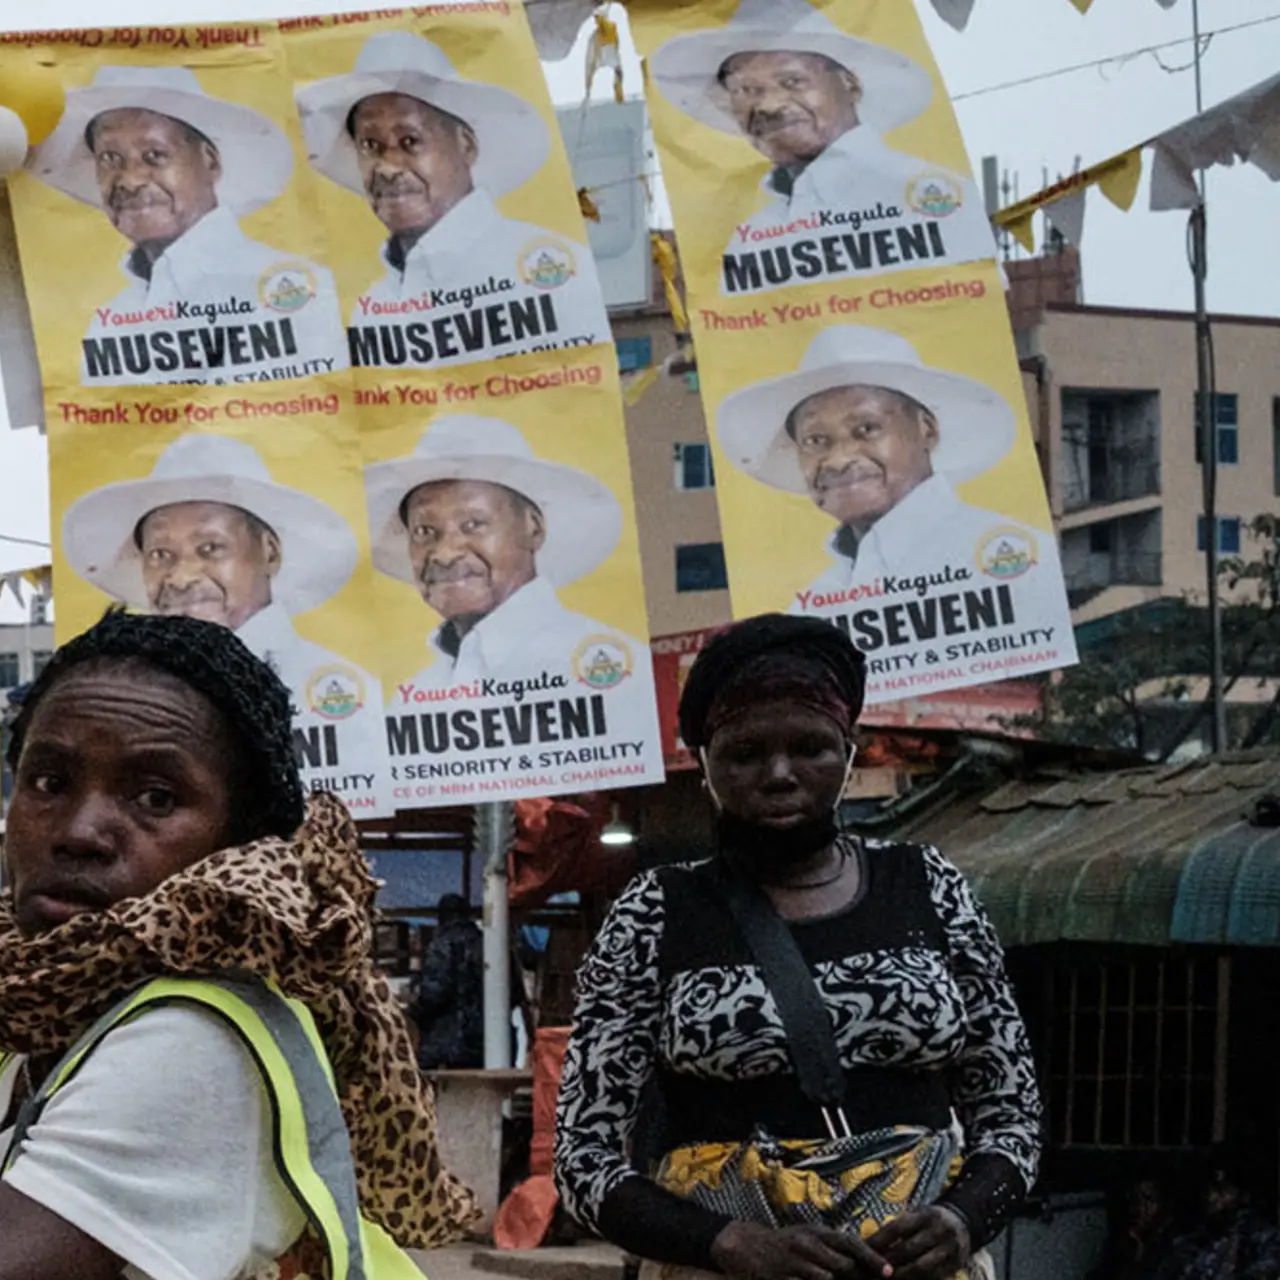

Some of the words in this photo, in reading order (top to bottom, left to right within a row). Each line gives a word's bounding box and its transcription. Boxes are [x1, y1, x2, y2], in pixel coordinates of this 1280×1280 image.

[723, 221, 946, 293] MUSEVENI
[346, 294, 558, 368] MUSEVENI
[699, 309, 767, 331] Thank
[773, 304, 821, 322] You
[828, 293, 863, 315] for
[868, 279, 986, 309] Choosing
[82, 317, 297, 378] MUSEVENI
[58, 402, 129, 425] Thank
[136, 404, 178, 425] You
[184, 402, 216, 423] for
[224, 391, 338, 420] Choosing
[354, 385, 390, 406] ank
[396, 385, 437, 406] You
[443, 380, 479, 402] for
[485, 363, 602, 398] Choosing
[925, 650, 940, 664] &
[946, 627, 1055, 661] STABILITY
[386, 694, 606, 756] MUSEVENI
[404, 757, 512, 779] SENIORITY
[518, 756, 533, 770] &
[539, 742, 645, 768] STABILITY
